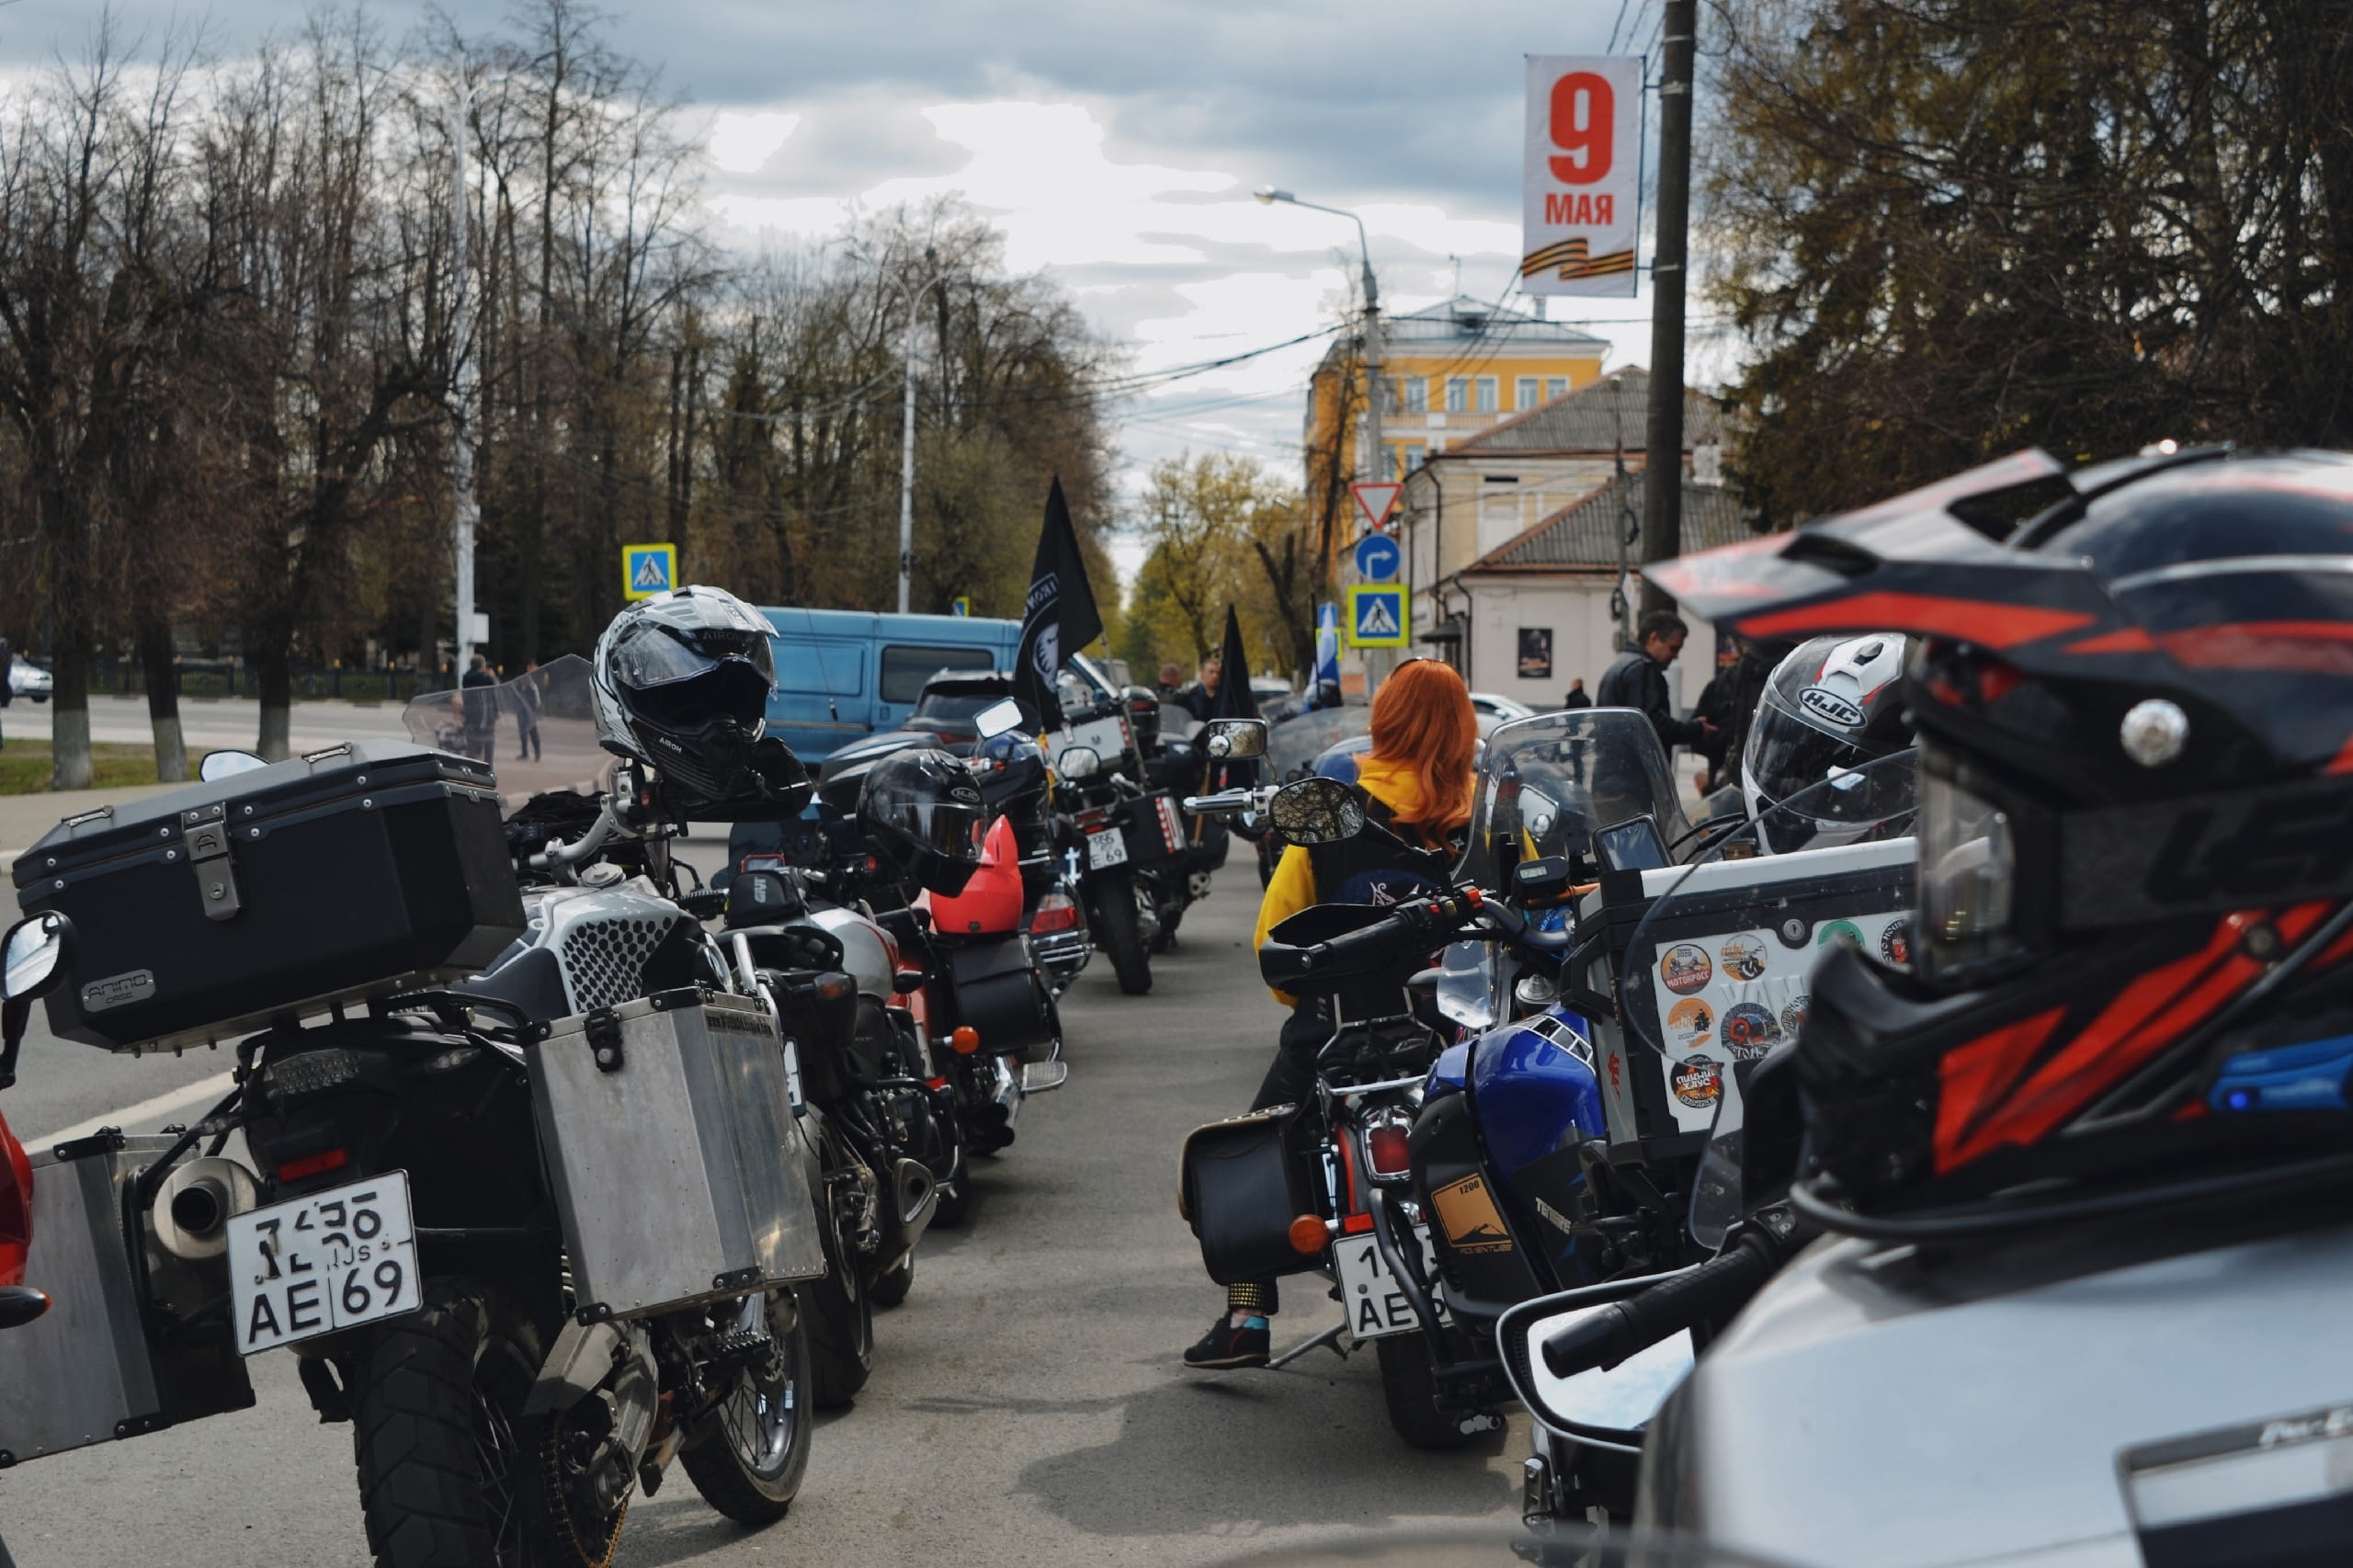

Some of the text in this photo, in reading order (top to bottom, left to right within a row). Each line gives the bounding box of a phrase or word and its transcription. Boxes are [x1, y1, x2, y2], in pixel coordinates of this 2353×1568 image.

[1548, 71, 1615, 187] 9
[1545, 193, 1614, 225] МАЯ
[1803, 691, 1859, 722] HJC
[658, 736, 683, 754] AIROH
[1106, 848, 1122, 863] 69
[1666, 970, 1711, 988] МОТОКРОСС
[1459, 1179, 1481, 1195] 1200
[248, 1259, 403, 1344] AE 69
[1358, 1291, 1413, 1332] AE
